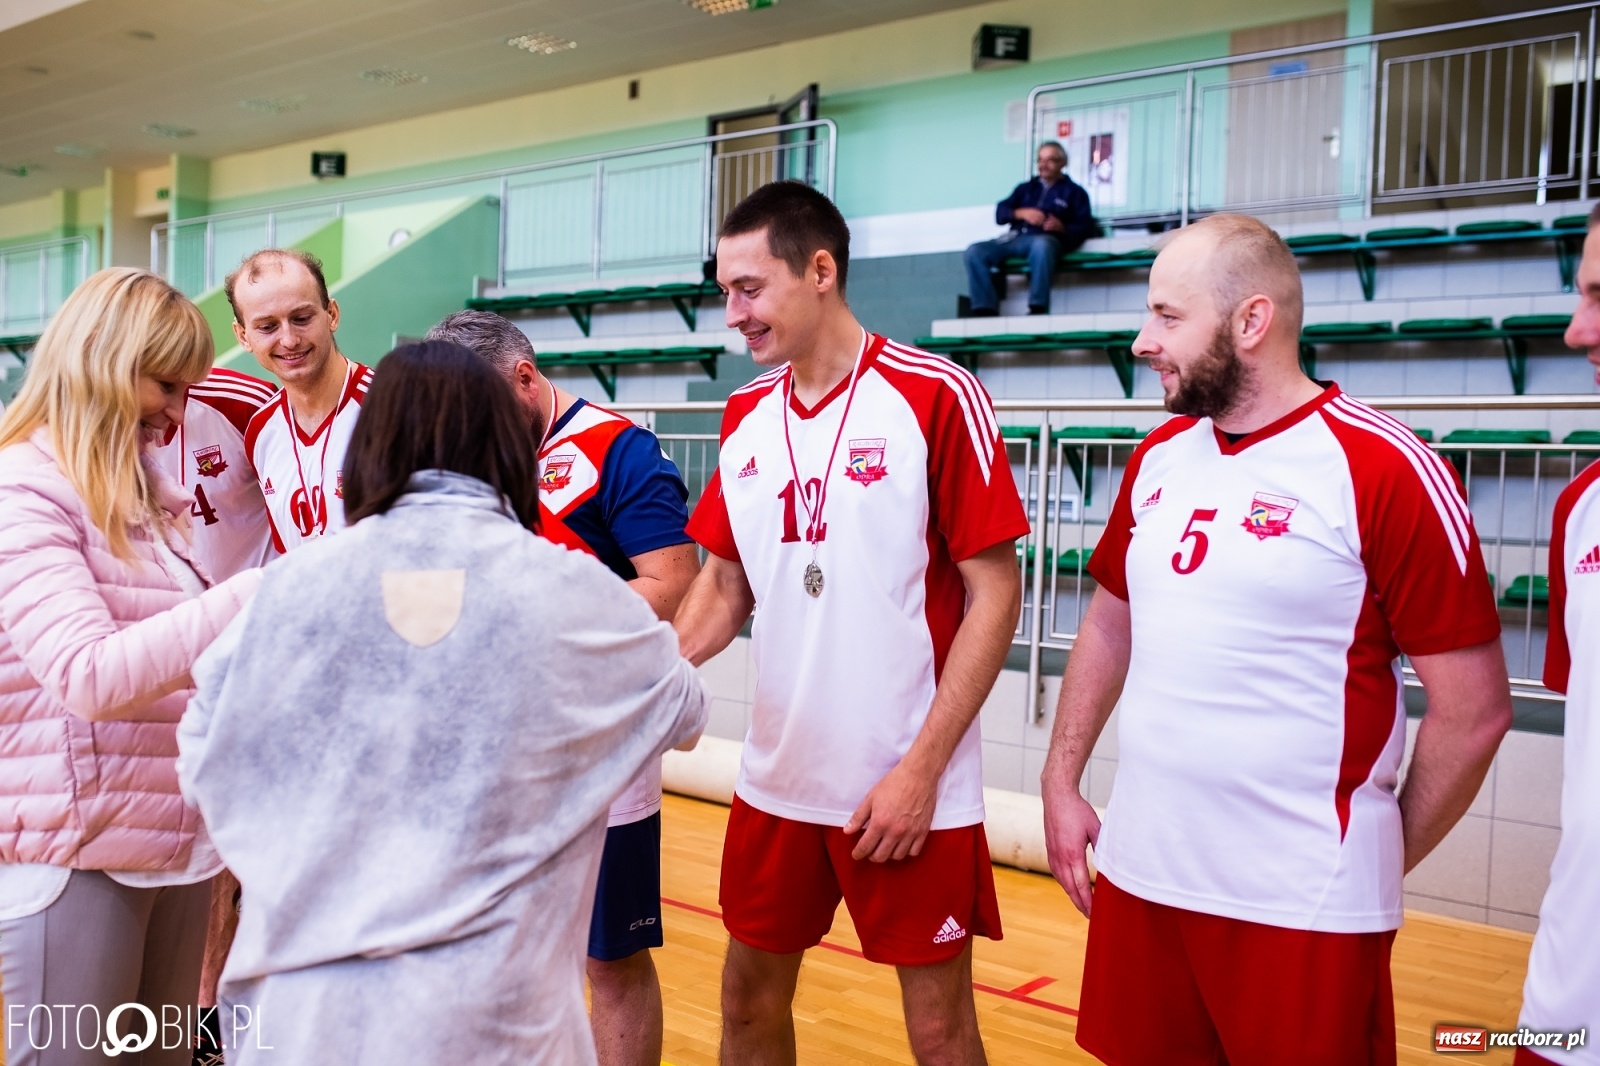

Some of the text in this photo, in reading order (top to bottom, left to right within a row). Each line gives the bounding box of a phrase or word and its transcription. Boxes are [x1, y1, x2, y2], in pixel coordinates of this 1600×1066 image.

[995, 36, 1017, 57] F
[191, 484, 219, 526] 4
[778, 478, 827, 543] 12
[1172, 509, 1218, 575] 5
[933, 928, 966, 944] adidas
